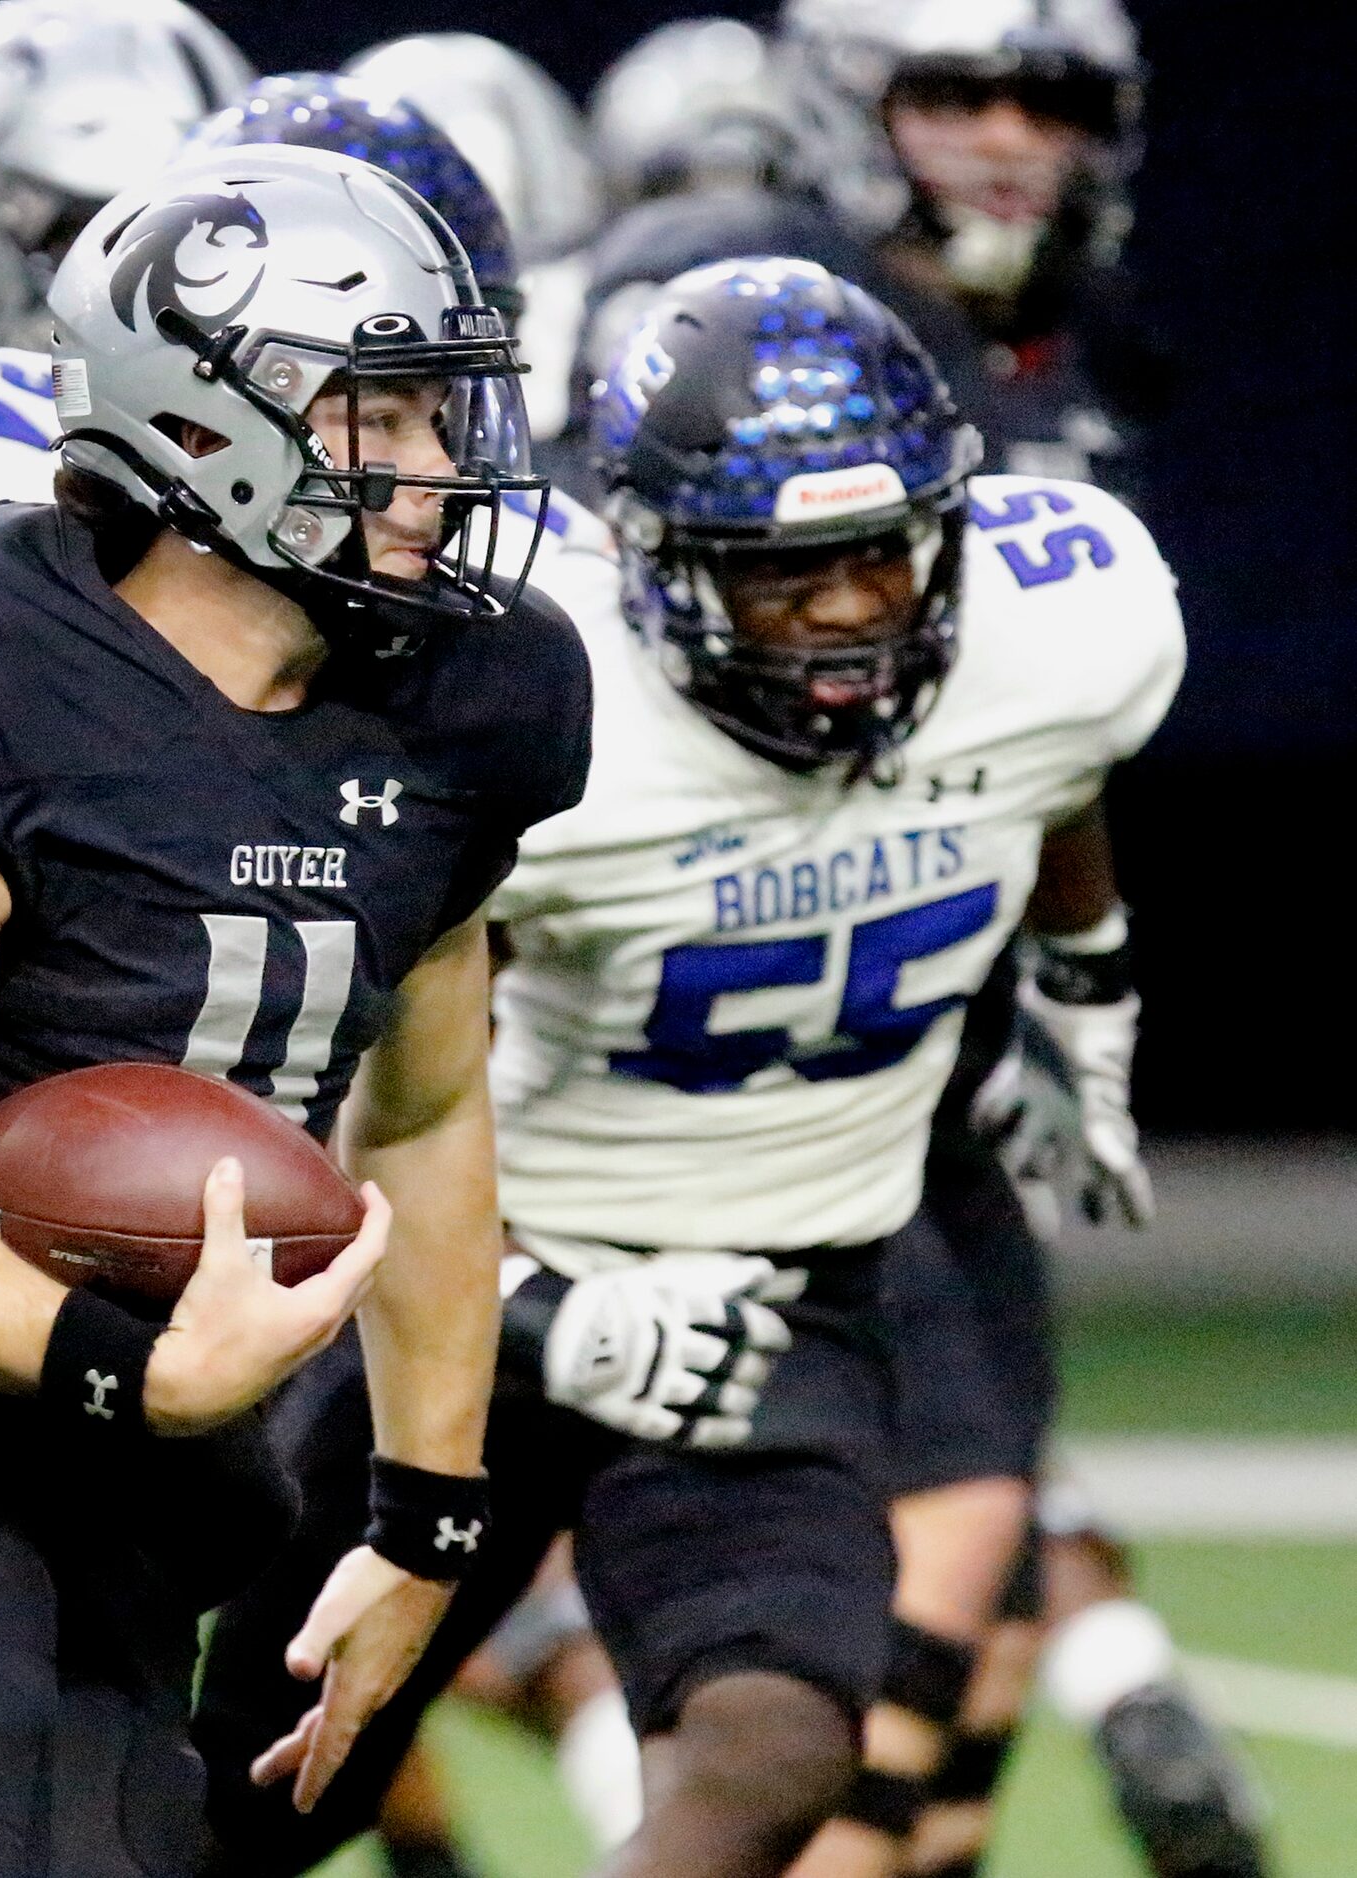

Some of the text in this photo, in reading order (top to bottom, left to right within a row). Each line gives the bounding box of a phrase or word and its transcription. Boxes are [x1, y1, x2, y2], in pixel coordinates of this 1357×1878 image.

[968, 489, 1115, 589] 55
[230, 844, 348, 887] GUYER
[712, 825, 966, 933] BOBCATS
[181, 913, 356, 1122] 11
[609, 880, 1001, 1094] 55
